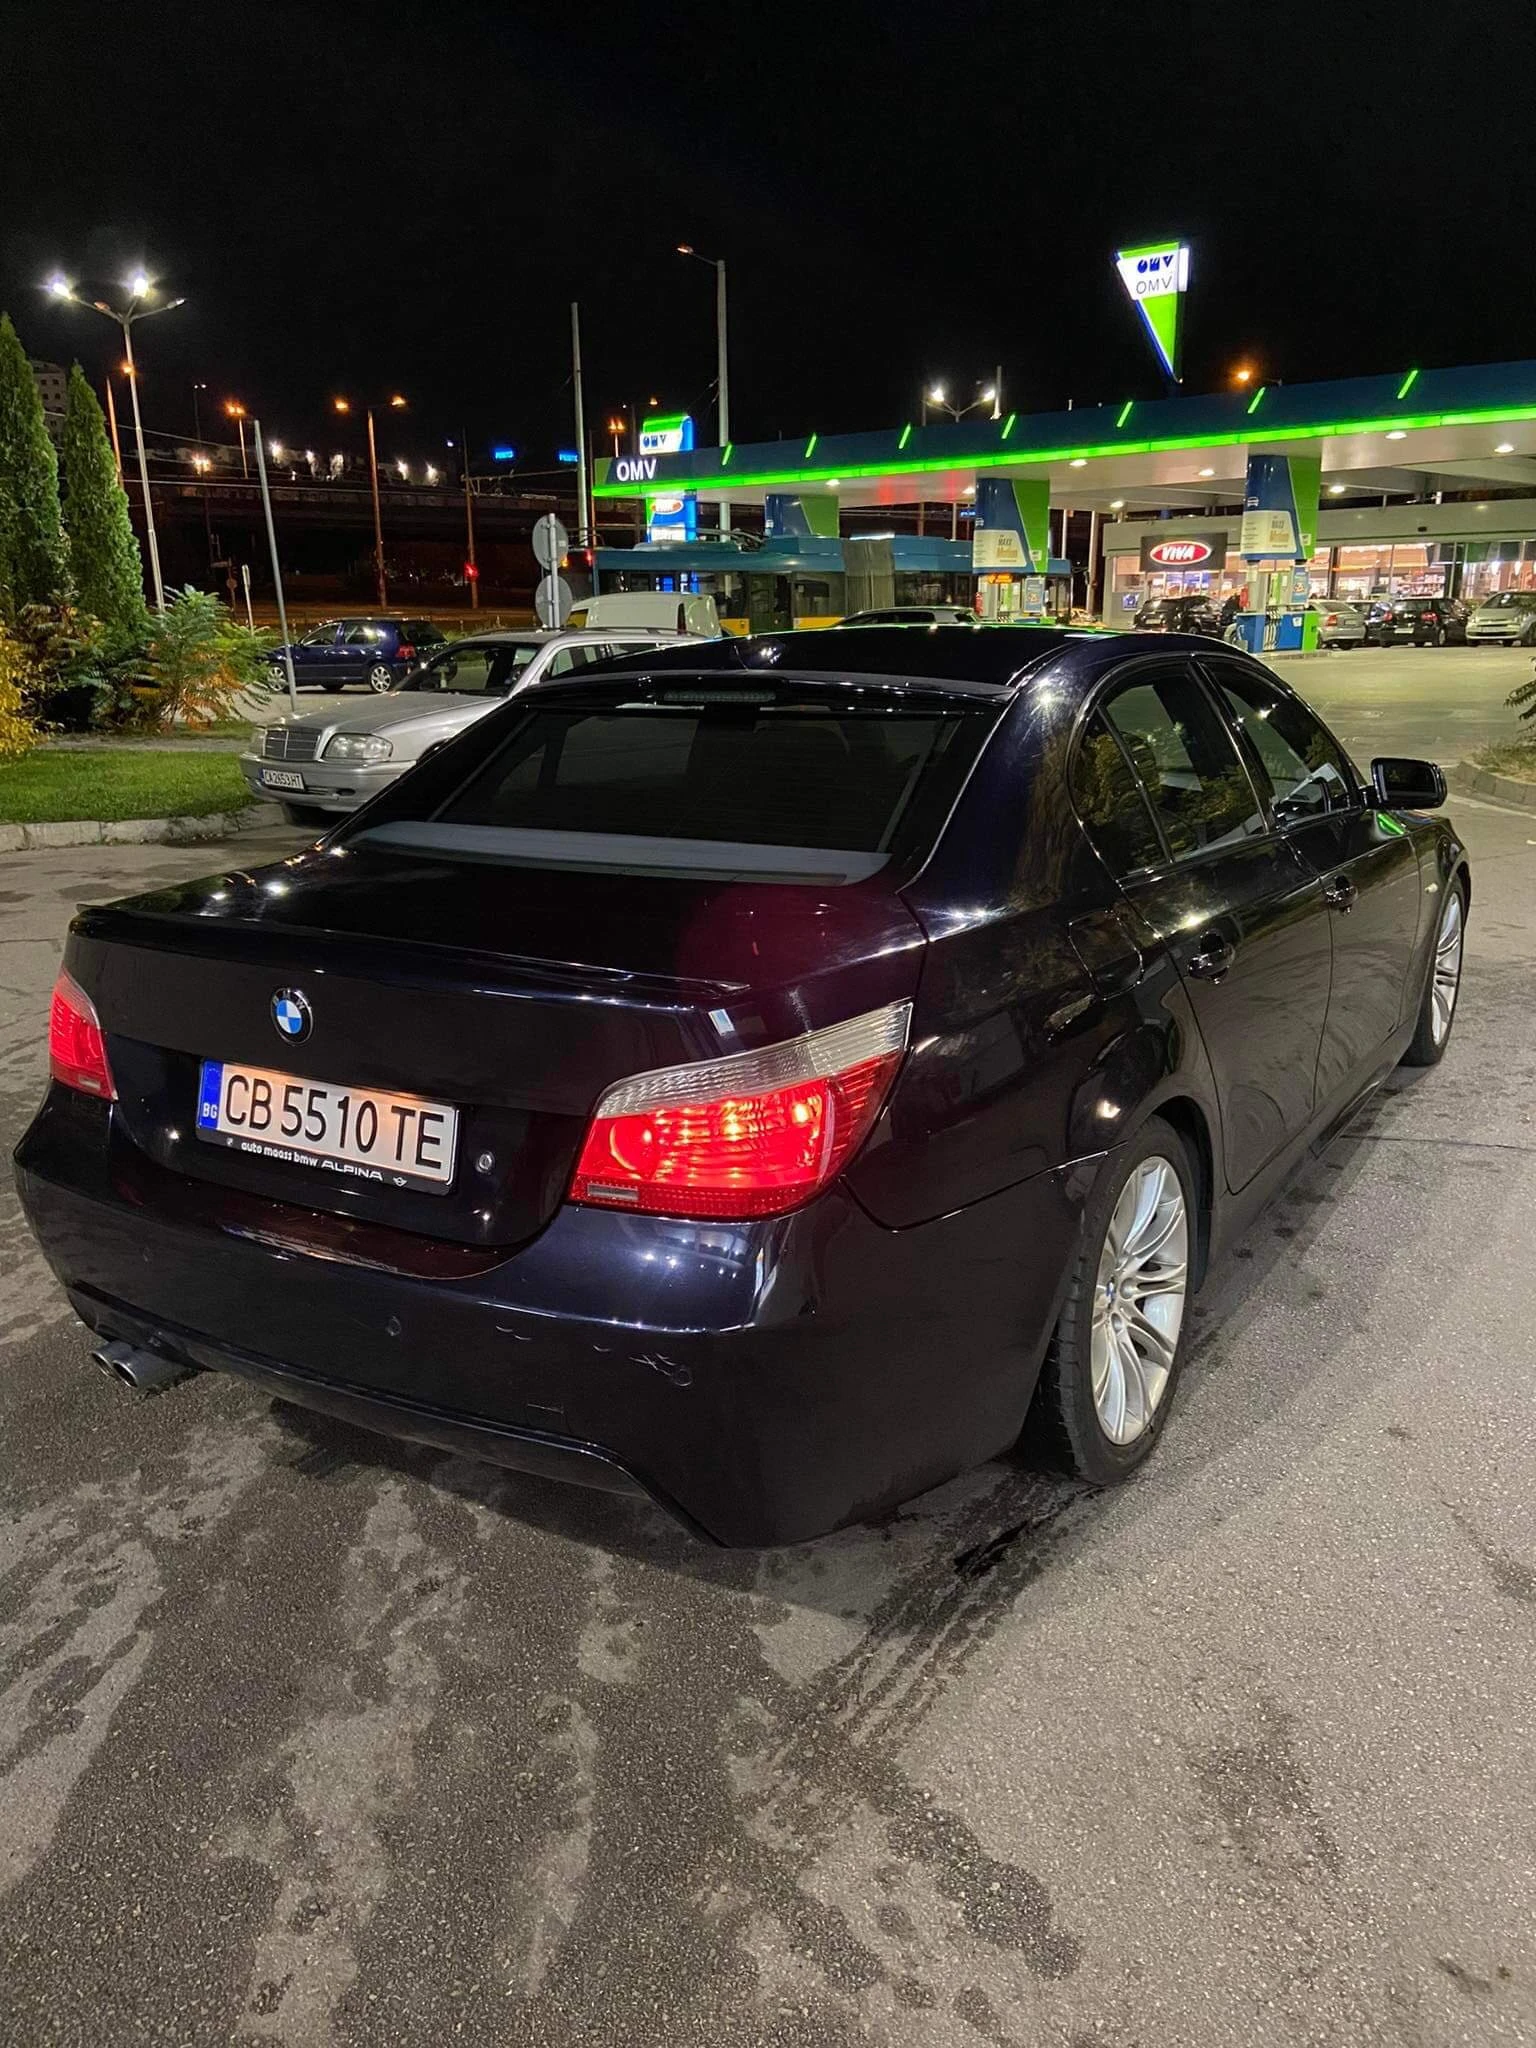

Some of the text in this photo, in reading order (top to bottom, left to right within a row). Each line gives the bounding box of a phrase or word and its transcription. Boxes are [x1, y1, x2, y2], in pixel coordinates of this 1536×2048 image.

[1136, 276, 1172, 294] OMV
[616, 459, 657, 482] OMV
[1161, 545, 1196, 561] VIVA
[203, 1103, 218, 1119] BG
[225, 1074, 444, 1170] CB 5510 TE
[241, 1141, 263, 1155] auto
[293, 1151, 319, 1168] bmw
[320, 1159, 384, 1182] ALPINA
